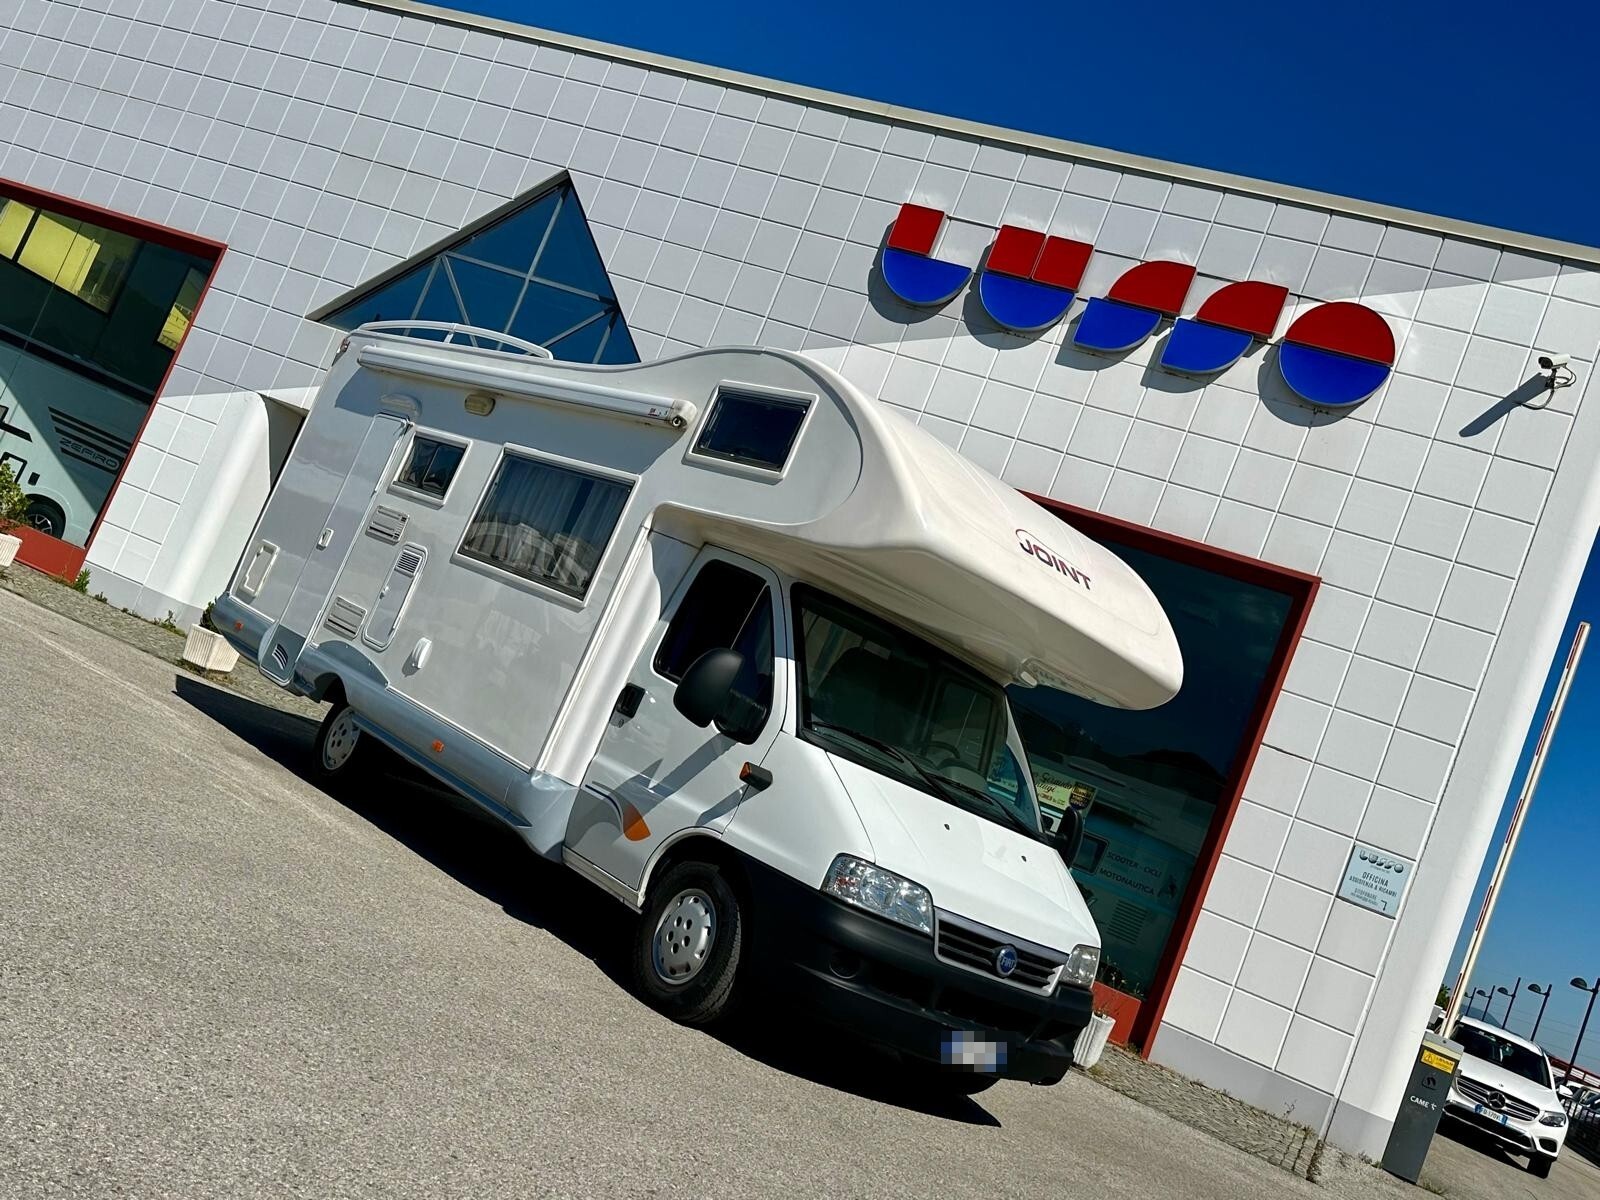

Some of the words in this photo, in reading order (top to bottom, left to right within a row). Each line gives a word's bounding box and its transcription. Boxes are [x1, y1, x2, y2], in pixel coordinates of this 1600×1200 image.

[59, 437, 120, 469] ZEFIRO
[1018, 539, 1092, 591] JOINT
[1107, 850, 1139, 872] SCOOTER
[1100, 868, 1155, 895] MOTONAUTICA
[1362, 871, 1389, 887] OFFICINA
[1001, 956, 1017, 970] FIAT
[1410, 1095, 1430, 1110] CAME
